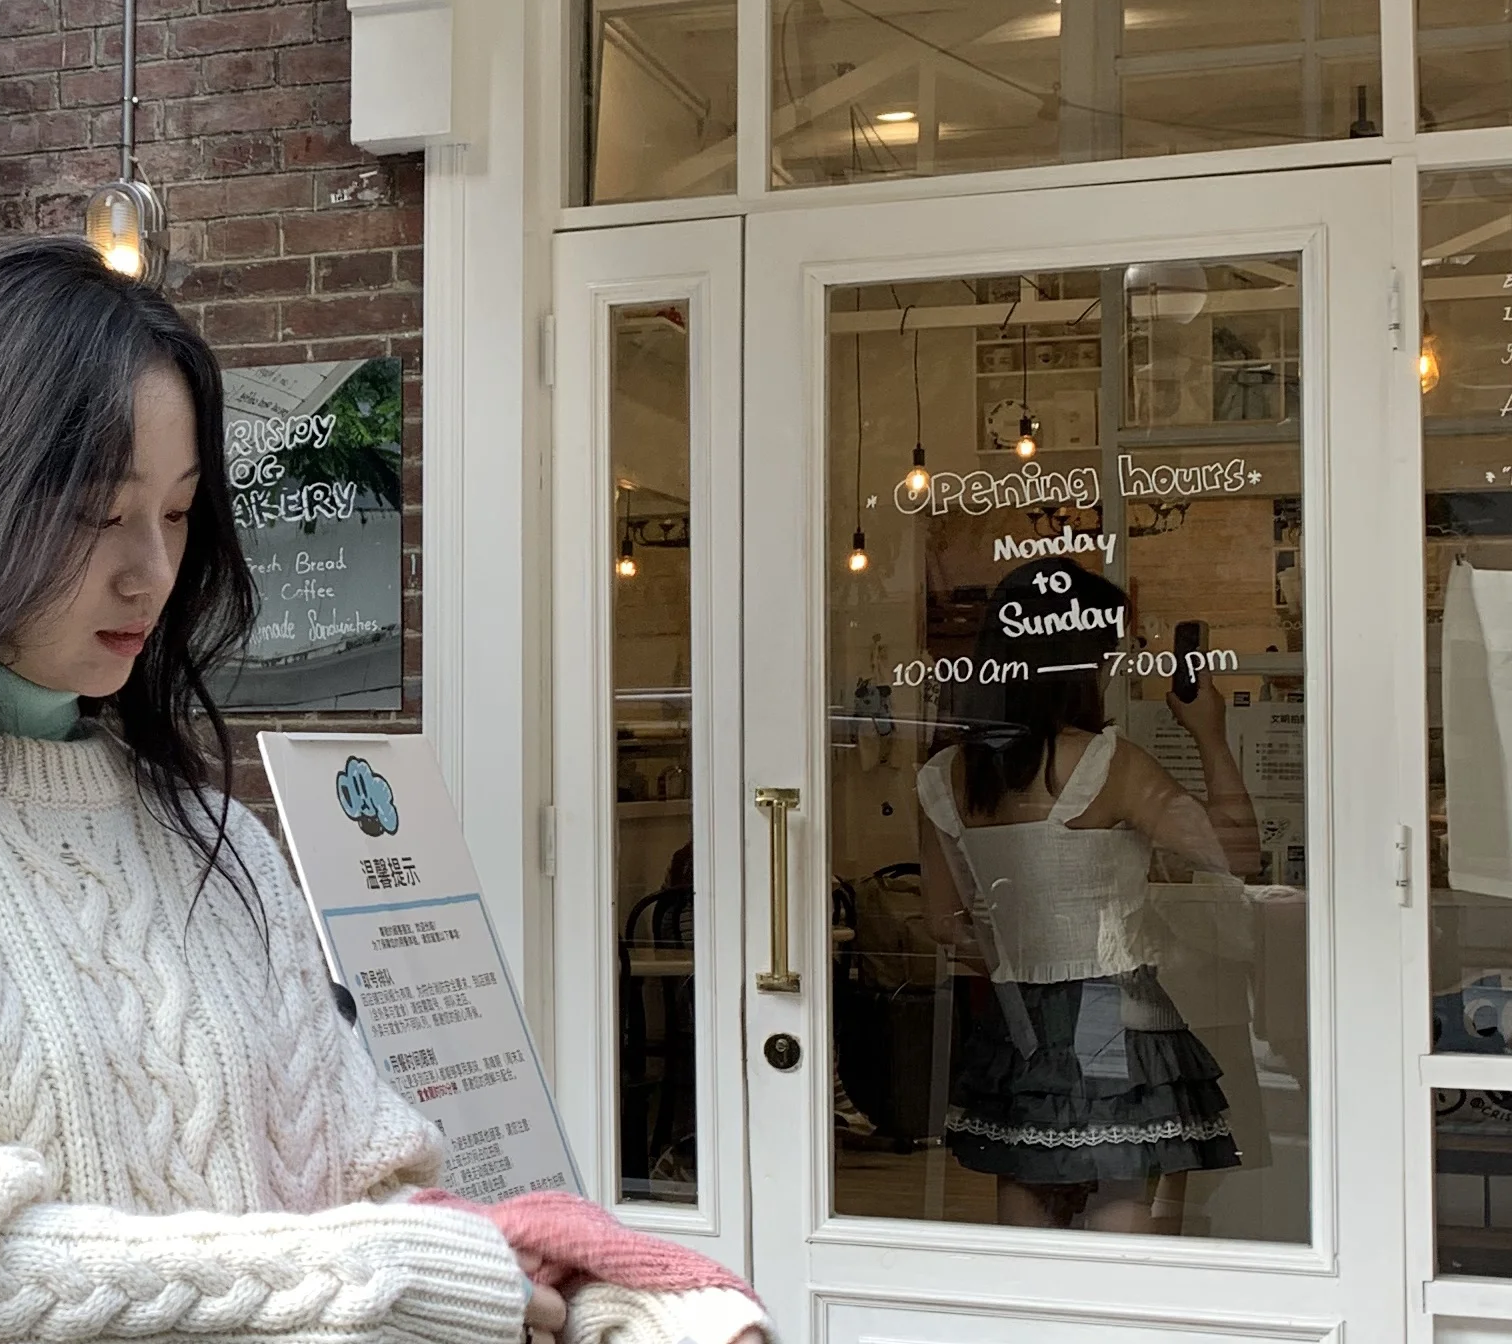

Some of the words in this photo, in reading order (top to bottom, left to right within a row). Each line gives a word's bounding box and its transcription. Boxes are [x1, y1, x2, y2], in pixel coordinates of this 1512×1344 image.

[225, 414, 336, 456] RISPY
[230, 454, 285, 489] OG
[232, 481, 357, 528] AKERY
[295, 547, 347, 574] Bread
[993, 525, 1117, 565] Monday
[281, 578, 336, 602] Coffee
[1032, 570, 1072, 595] to
[999, 598, 1125, 639] Sunday
[893, 656, 973, 687] 10:00
[979, 658, 1029, 685] am
[1103, 650, 1178, 679] 7:00
[1185, 648, 1240, 685] pm
[360, 856, 421, 890] 温馨提示
